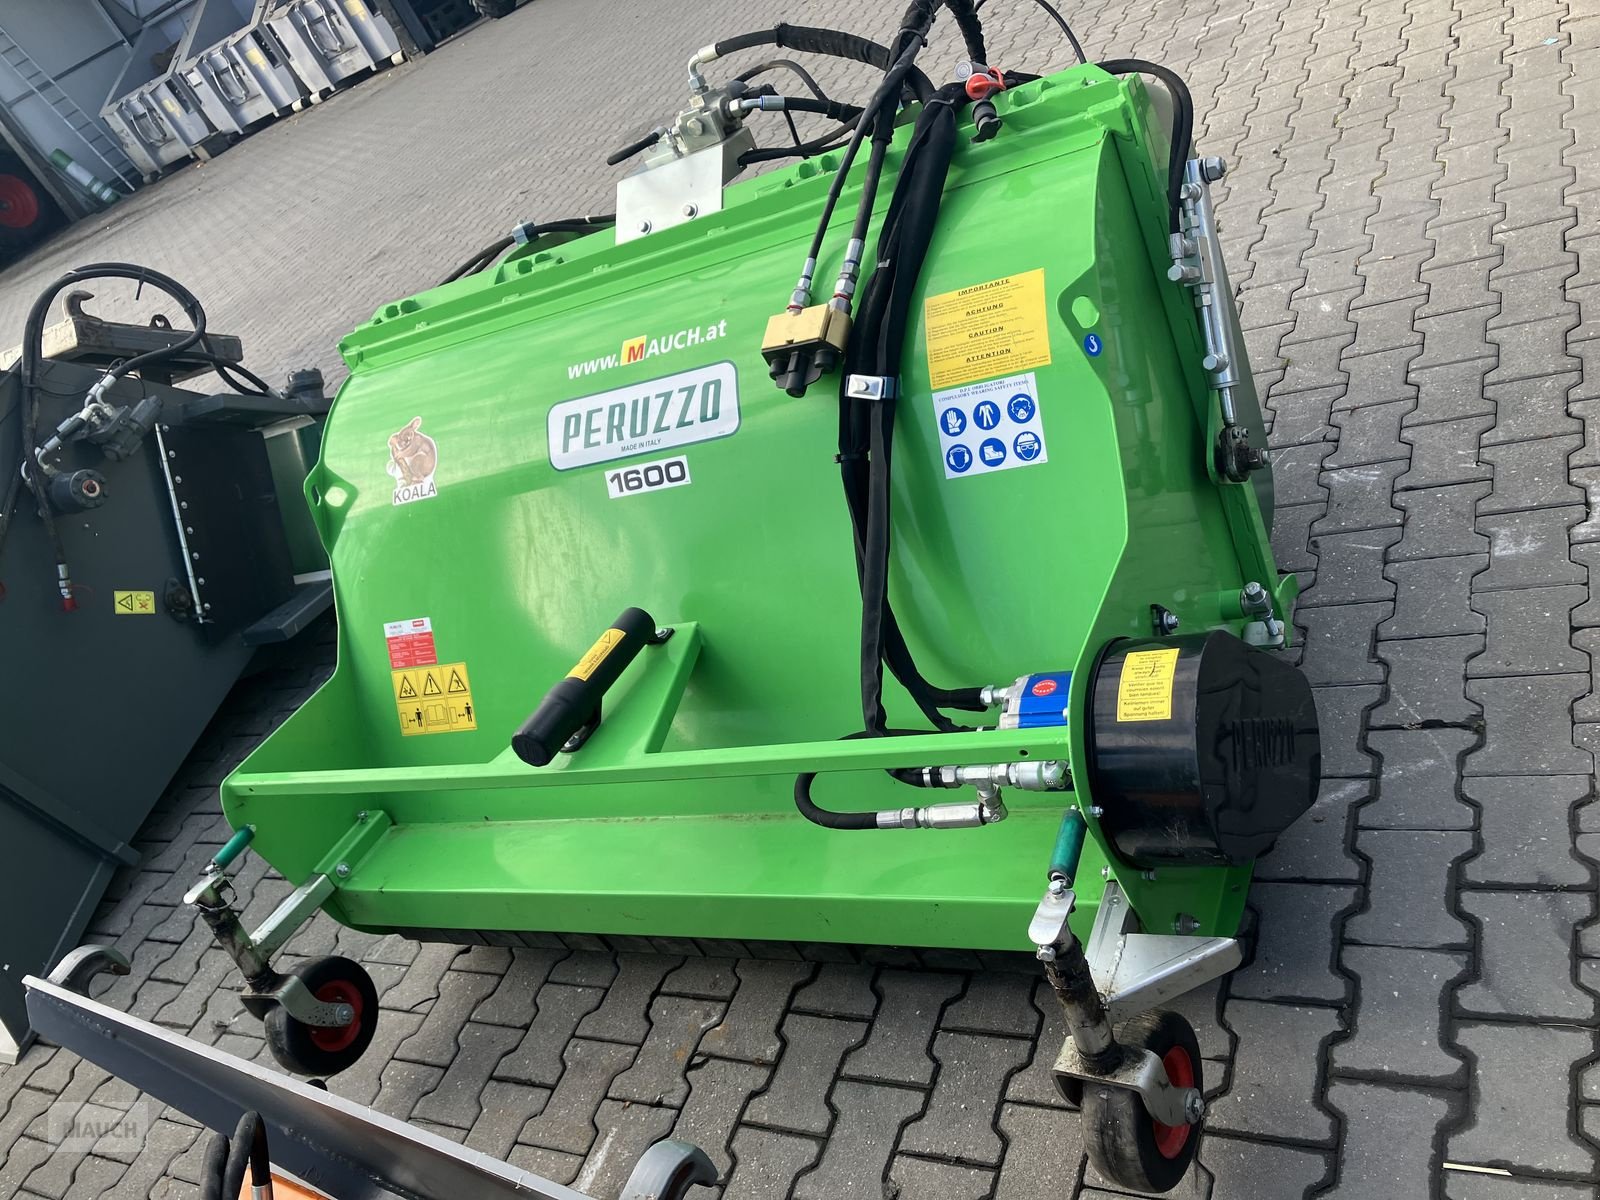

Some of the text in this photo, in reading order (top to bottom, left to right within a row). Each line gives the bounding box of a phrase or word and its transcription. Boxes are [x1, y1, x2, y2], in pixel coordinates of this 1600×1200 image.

[958, 278, 1010, 297] IMPORTANTE
[965, 302, 1004, 316] ACHTUNG
[968, 325, 1004, 339] CAUTION
[567, 319, 727, 379] www.MAUCH.at
[966, 348, 1011, 363] ATTENTION
[562, 378, 722, 453] PERUZZO
[621, 438, 661, 452] MADE IN ITALY
[609, 460, 686, 493] 1600
[393, 482, 436, 504] KOALA
